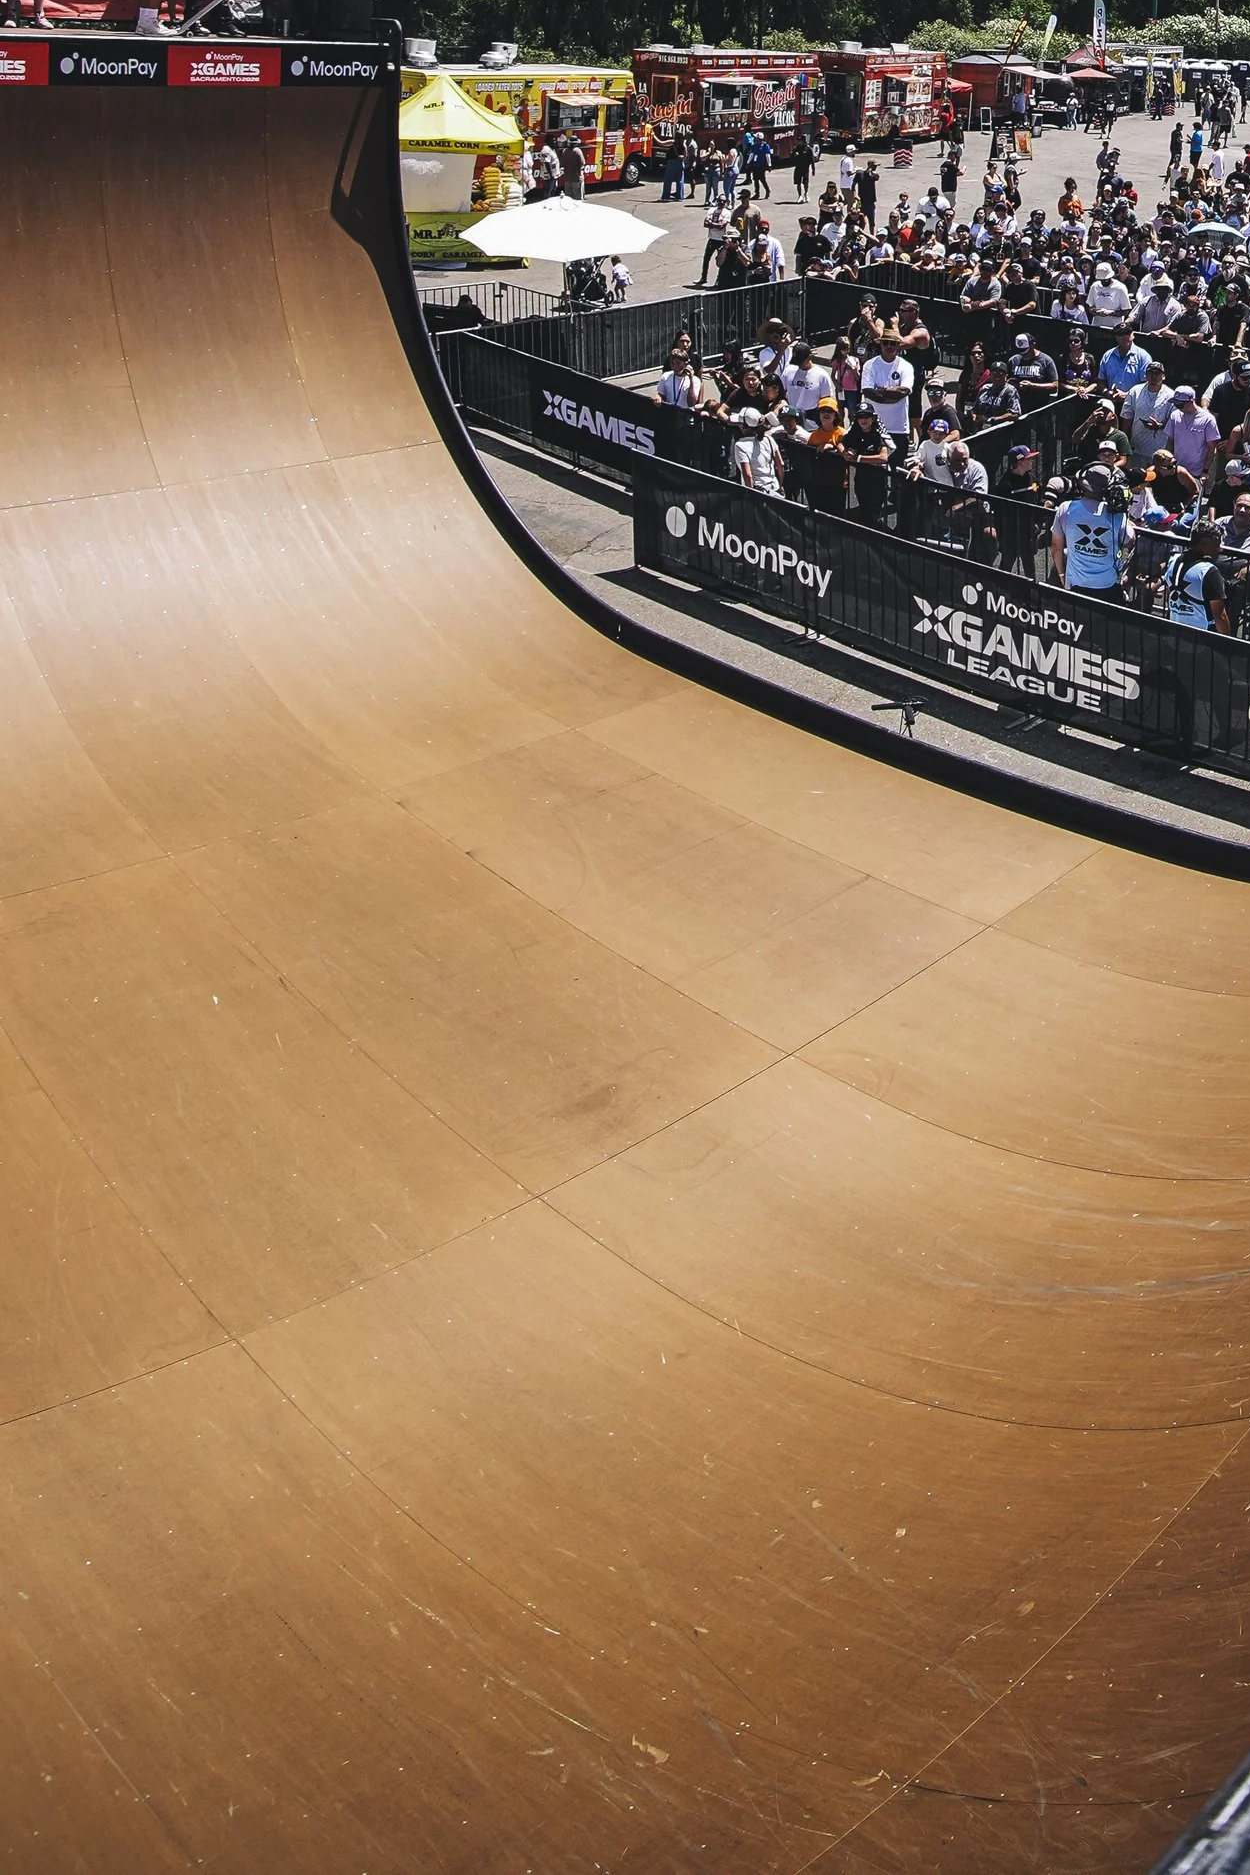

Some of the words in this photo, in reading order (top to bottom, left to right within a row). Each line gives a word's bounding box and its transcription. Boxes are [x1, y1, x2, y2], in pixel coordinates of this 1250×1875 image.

[213, 53, 244, 62] MoonPay
[81, 58, 157, 78] MoonPay
[190, 62, 261, 77] XGAMES
[309, 60, 379, 79] MoonPay
[638, 82, 648, 93] LA
[773, 110, 796, 127] TACOS
[408, 139, 453, 148] CARAMEL
[454, 141, 480, 149] CORN
[542, 389, 656, 455] XGAMES
[698, 515, 833, 598] MoonPay
[1074, 544, 1109, 555] GAMES
[986, 590, 1084, 642] MoonPay
[912, 595, 1141, 701] XGAMES
[946, 647, 1101, 713] LEAGUE
